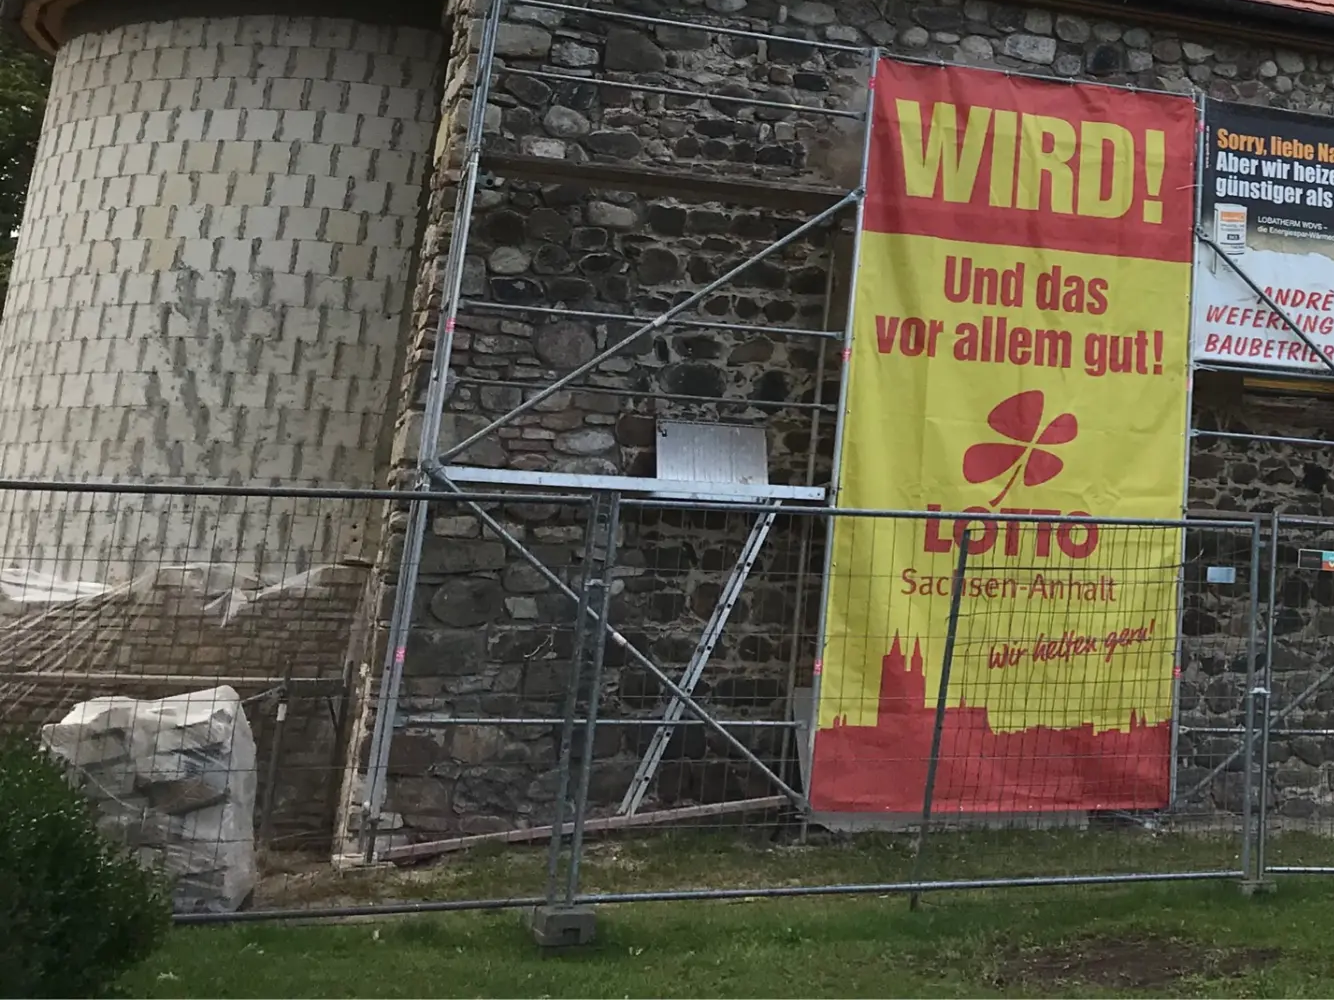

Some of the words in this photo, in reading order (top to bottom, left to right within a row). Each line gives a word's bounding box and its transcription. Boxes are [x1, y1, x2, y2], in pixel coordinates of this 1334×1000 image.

[896, 98, 1165, 225] WIRD!
[1216, 151, 1259, 176] Aber
[1261, 159, 1291, 180] wir
[1217, 128, 1267, 156] Sorry,
[1270, 135, 1315, 161] liebe
[1215, 175, 1303, 205] günstiger
[1305, 187, 1334, 209] als
[943, 256, 1025, 309] Und
[1035, 265, 1109, 315] das
[875, 315, 945, 357] vor
[953, 316, 1073, 369] allem
[1084, 330, 1164, 377] gut!
[923, 503, 1099, 559] LOTTO
[988, 640, 1028, 669] Wir
[1033, 630, 1097, 662] helfen
[1104, 618, 1156, 663] gern!
